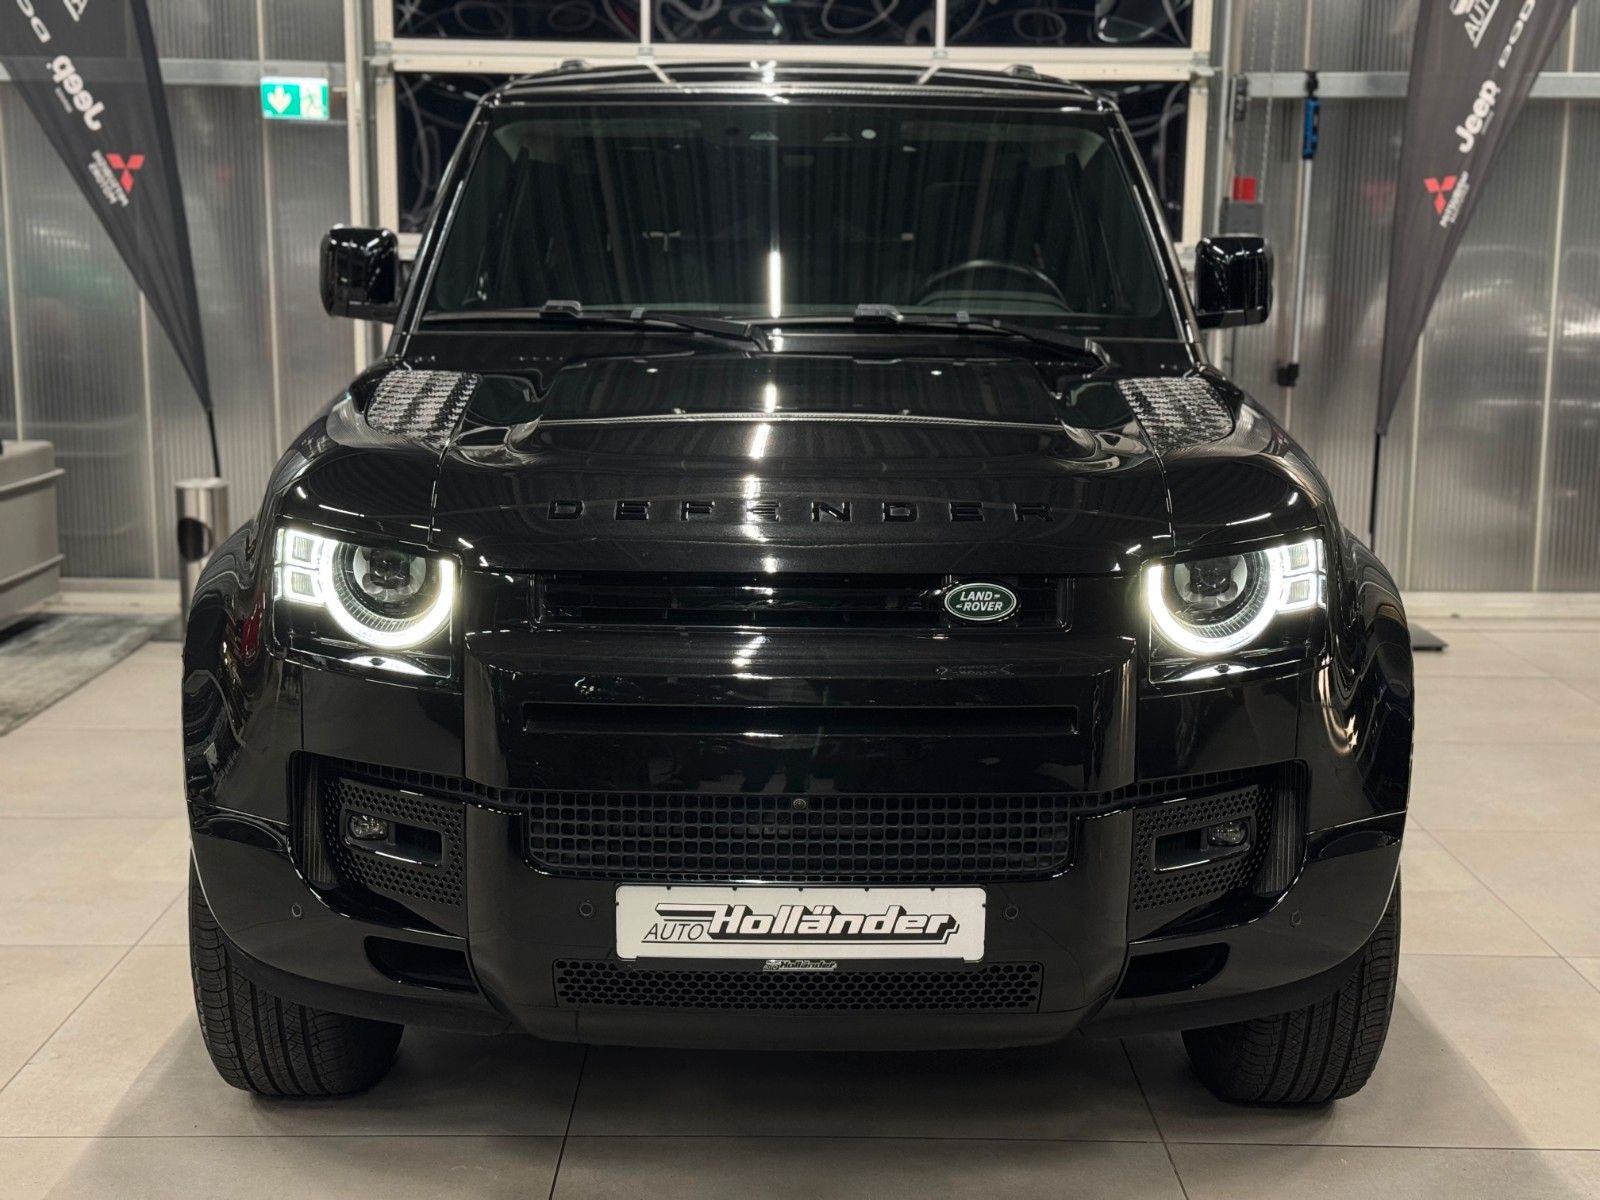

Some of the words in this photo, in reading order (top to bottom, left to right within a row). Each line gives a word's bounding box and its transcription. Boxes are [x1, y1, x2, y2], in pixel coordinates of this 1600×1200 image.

[1455, 80, 1500, 153] Jeep
[546, 500, 1054, 523] DEFENDER
[643, 922, 705, 941] AUTO
[707, 904, 958, 940] Holländer
